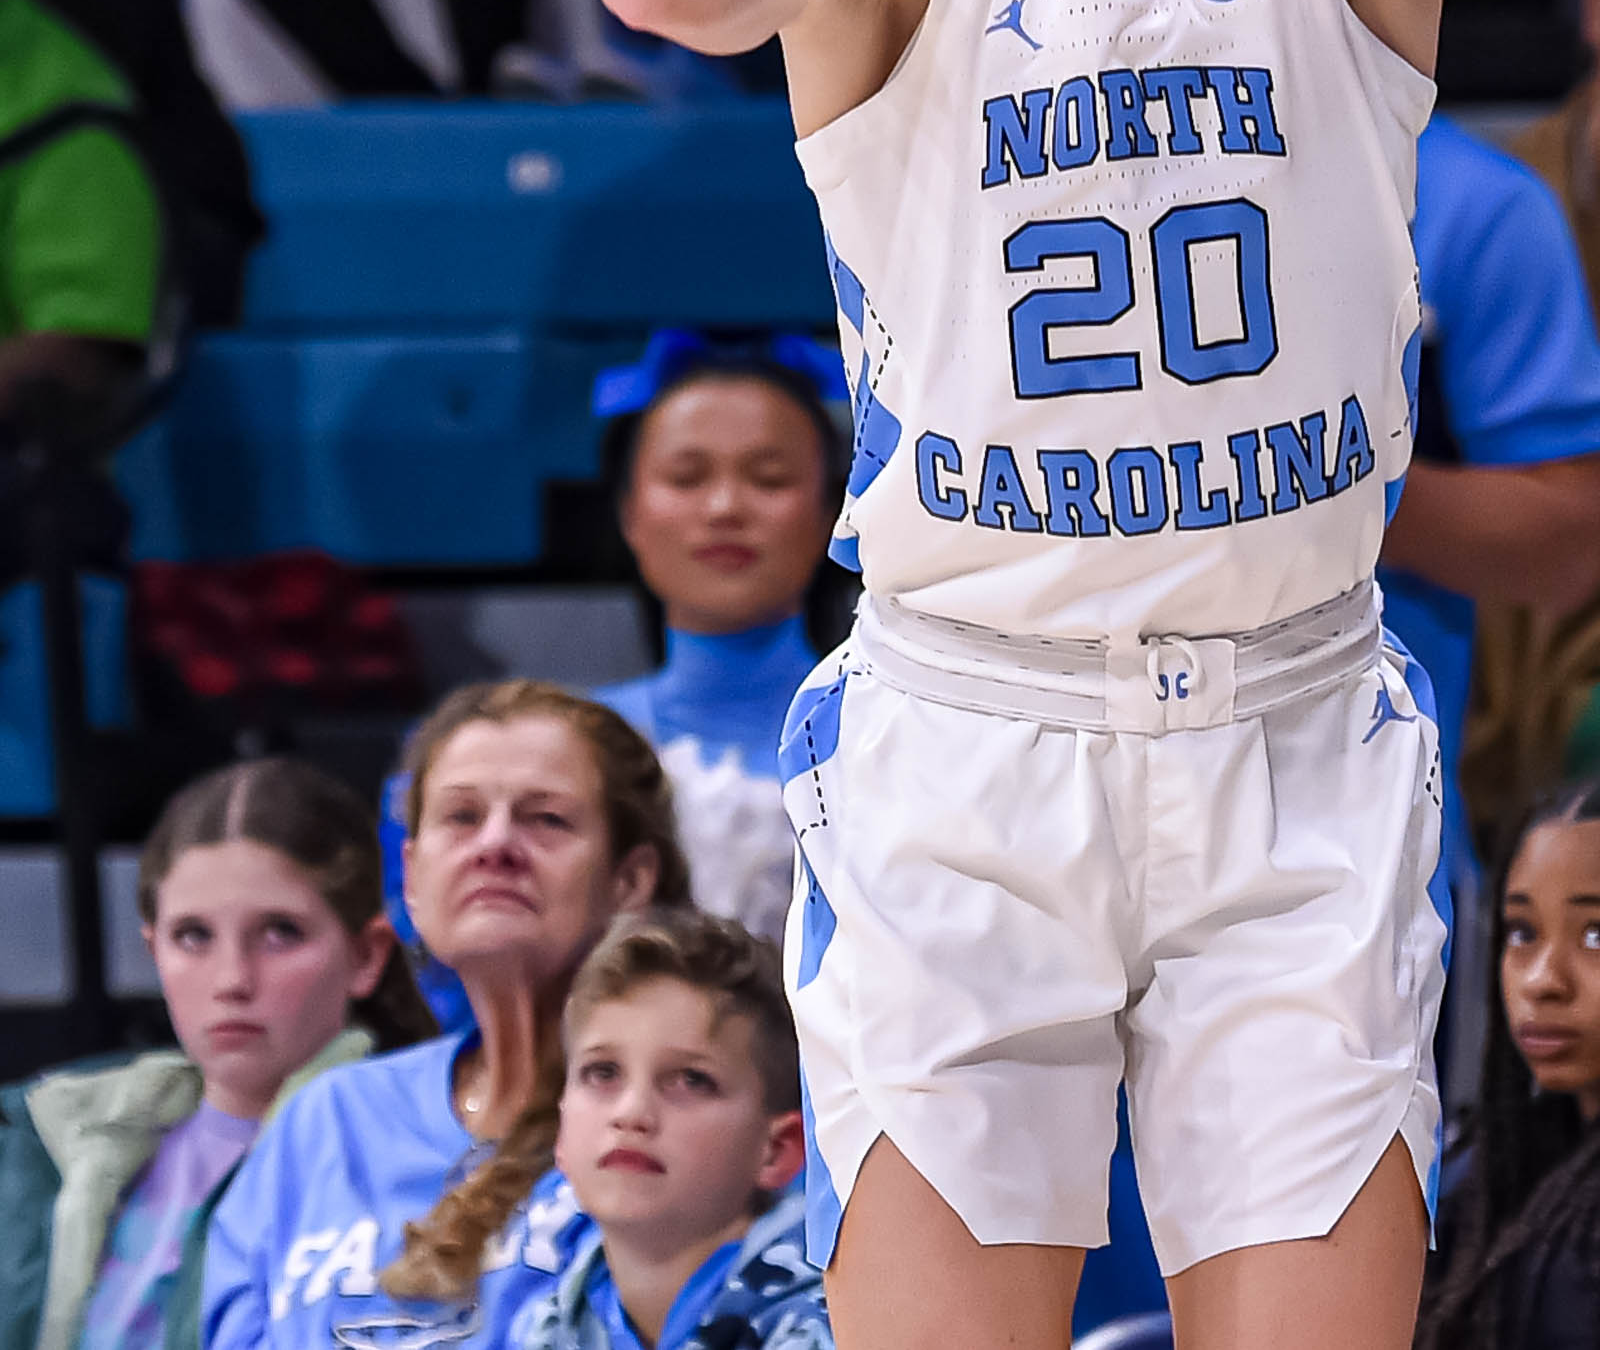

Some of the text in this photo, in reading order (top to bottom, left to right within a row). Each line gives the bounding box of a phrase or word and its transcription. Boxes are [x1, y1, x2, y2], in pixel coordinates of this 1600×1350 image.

[981, 65, 1288, 190] NORTH
[1003, 197, 1279, 400] 20
[915, 393, 1376, 538] CAROLINA
[271, 1185, 583, 1321] FAY
